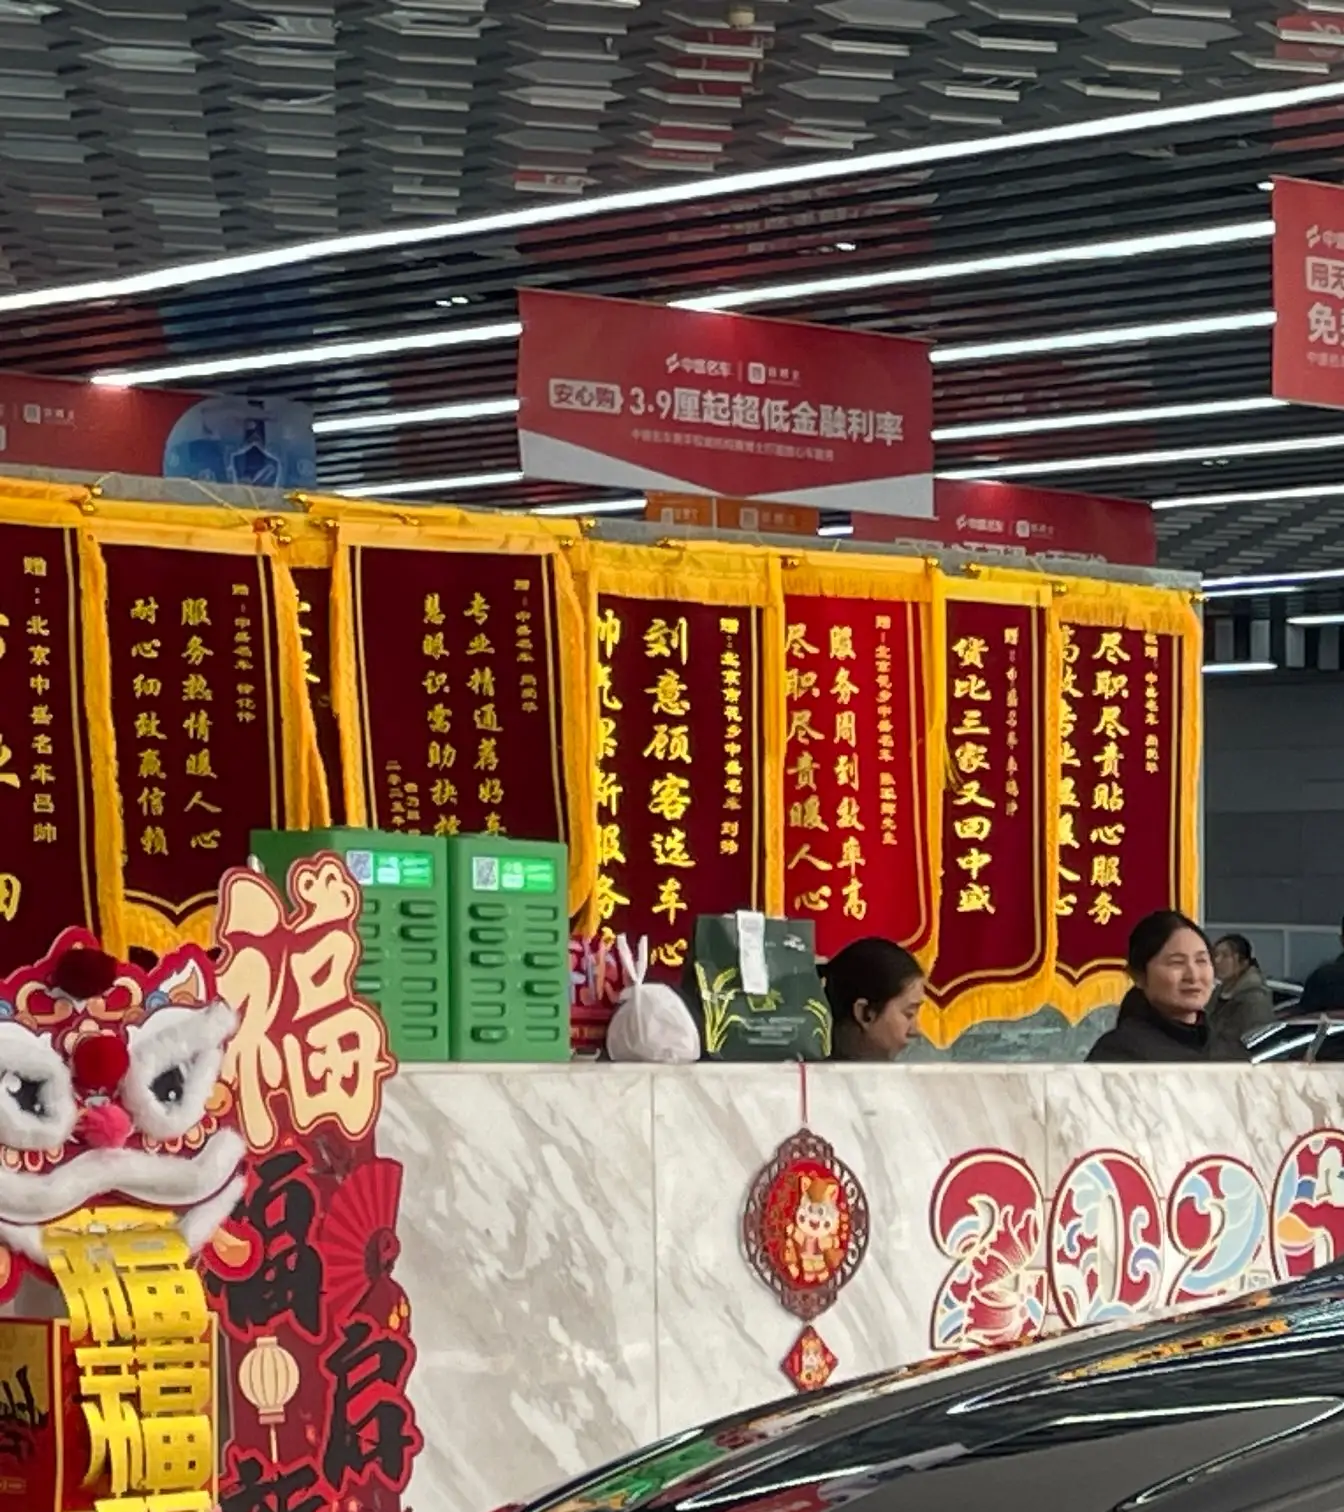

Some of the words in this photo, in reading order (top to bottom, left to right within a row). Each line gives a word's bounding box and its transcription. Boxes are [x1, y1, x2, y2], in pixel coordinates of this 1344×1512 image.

[553, 383, 617, 409] 安心购
[628, 385, 904, 447] 3.9厘起超低金融利率
[130, 596, 169, 857] 耐心细致赢信赖
[181, 597, 222, 849] 服务热情暖人心
[785, 621, 833, 912] 尽职尽责暖人心
[828, 624, 868, 921] 服务周到效率高
[951, 636, 996, 915] 货比三家又回中盛
[1087, 631, 1131, 926] 尽职尽责贴心服务
[217, 858, 397, 1149] 福
